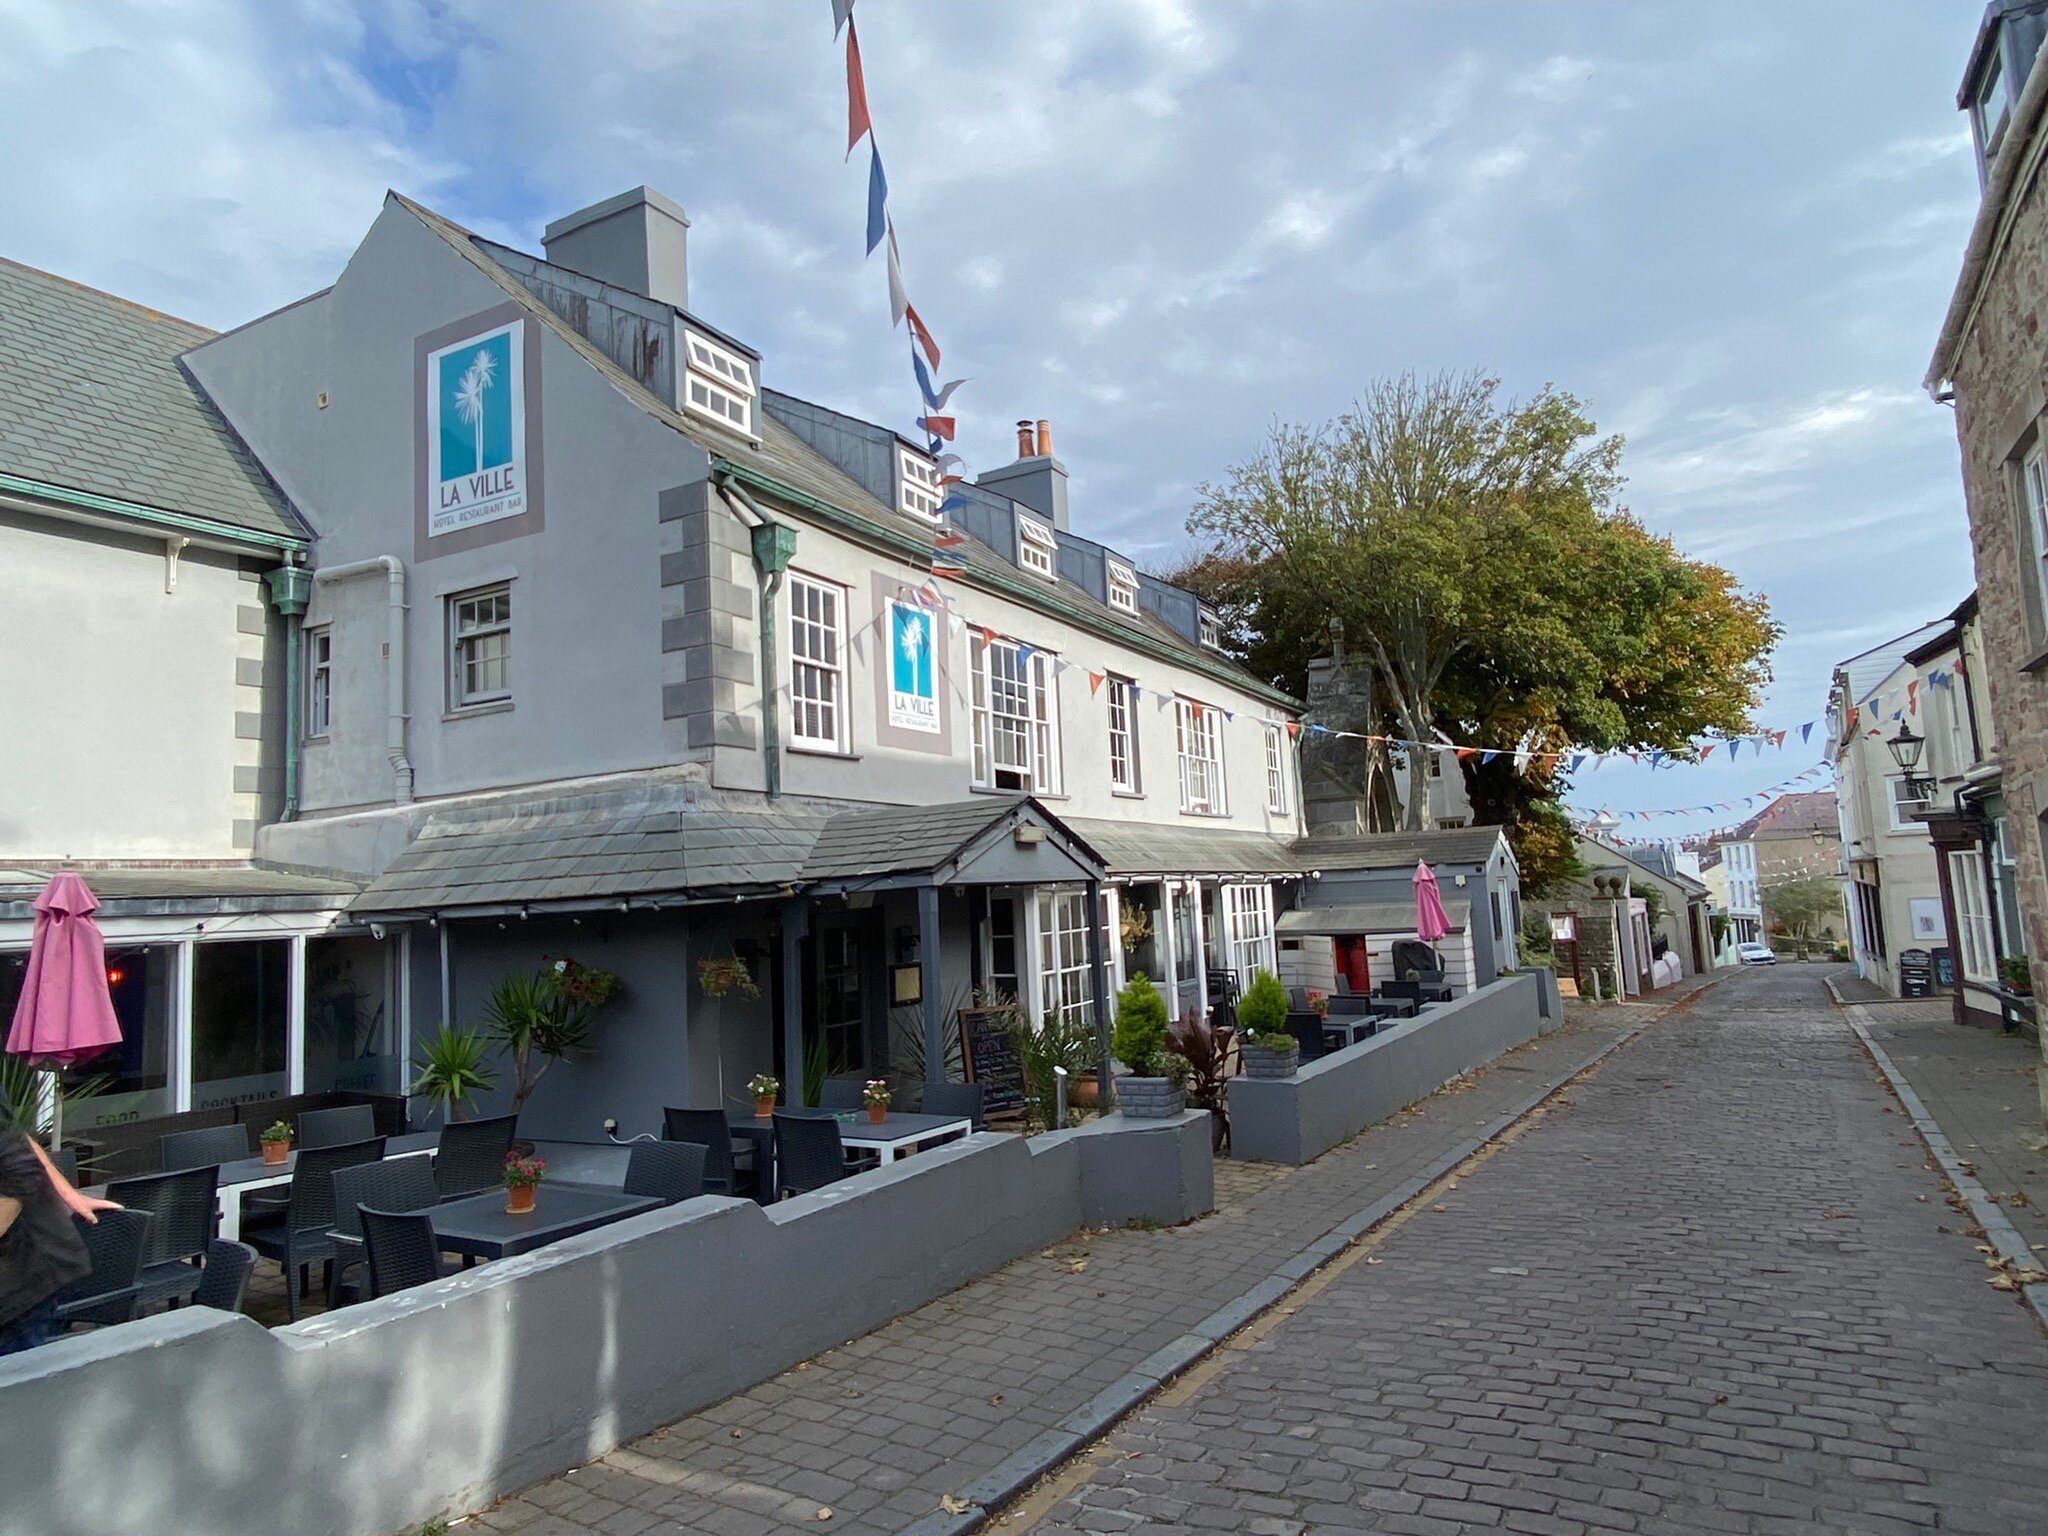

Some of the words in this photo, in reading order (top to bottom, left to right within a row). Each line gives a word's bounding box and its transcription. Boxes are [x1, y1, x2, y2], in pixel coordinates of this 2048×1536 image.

[441, 483, 461, 508] LA
[469, 467, 514, 499] VILLE
[433, 515, 455, 528] HOTEL
[459, 501, 504, 521] RESTAURANT
[508, 497, 522, 509] BAR
[894, 694, 907, 711] LA
[910, 697, 934, 716] VILLE
